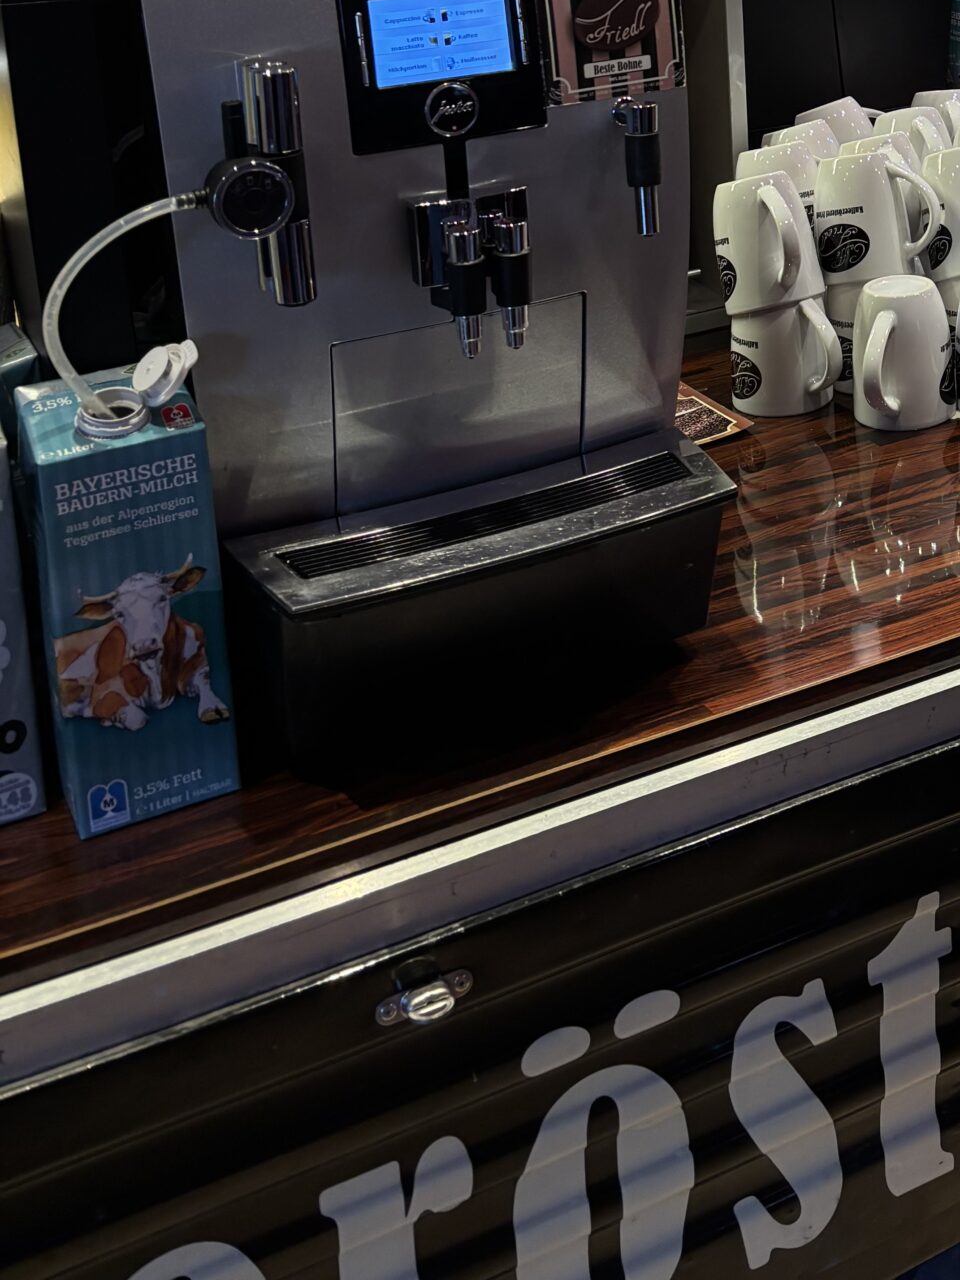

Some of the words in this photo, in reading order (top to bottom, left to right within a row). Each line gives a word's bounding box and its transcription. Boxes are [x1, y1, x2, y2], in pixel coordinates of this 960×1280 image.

[586, 1, 652, 44] Friedl
[594, 62, 615, 76] Beste
[618, 58, 643, 71] Bohne
[32, 395, 73, 413] 3,5%
[54, 453, 197, 500] BAYERISCHE
[56, 471, 199, 516] BAUERN-MILCH
[64, 524, 131, 547] Tegernsee
[134, 508, 199, 529] Schliersee
[66, 521, 89, 533] aus
[92, 514, 115, 527] der
[117, 496, 195, 520] Alpenregion
[133, 779, 170, 800] 3,5%
[172, 768, 203, 788] Fett
[155, 793, 182, 810] Liter
